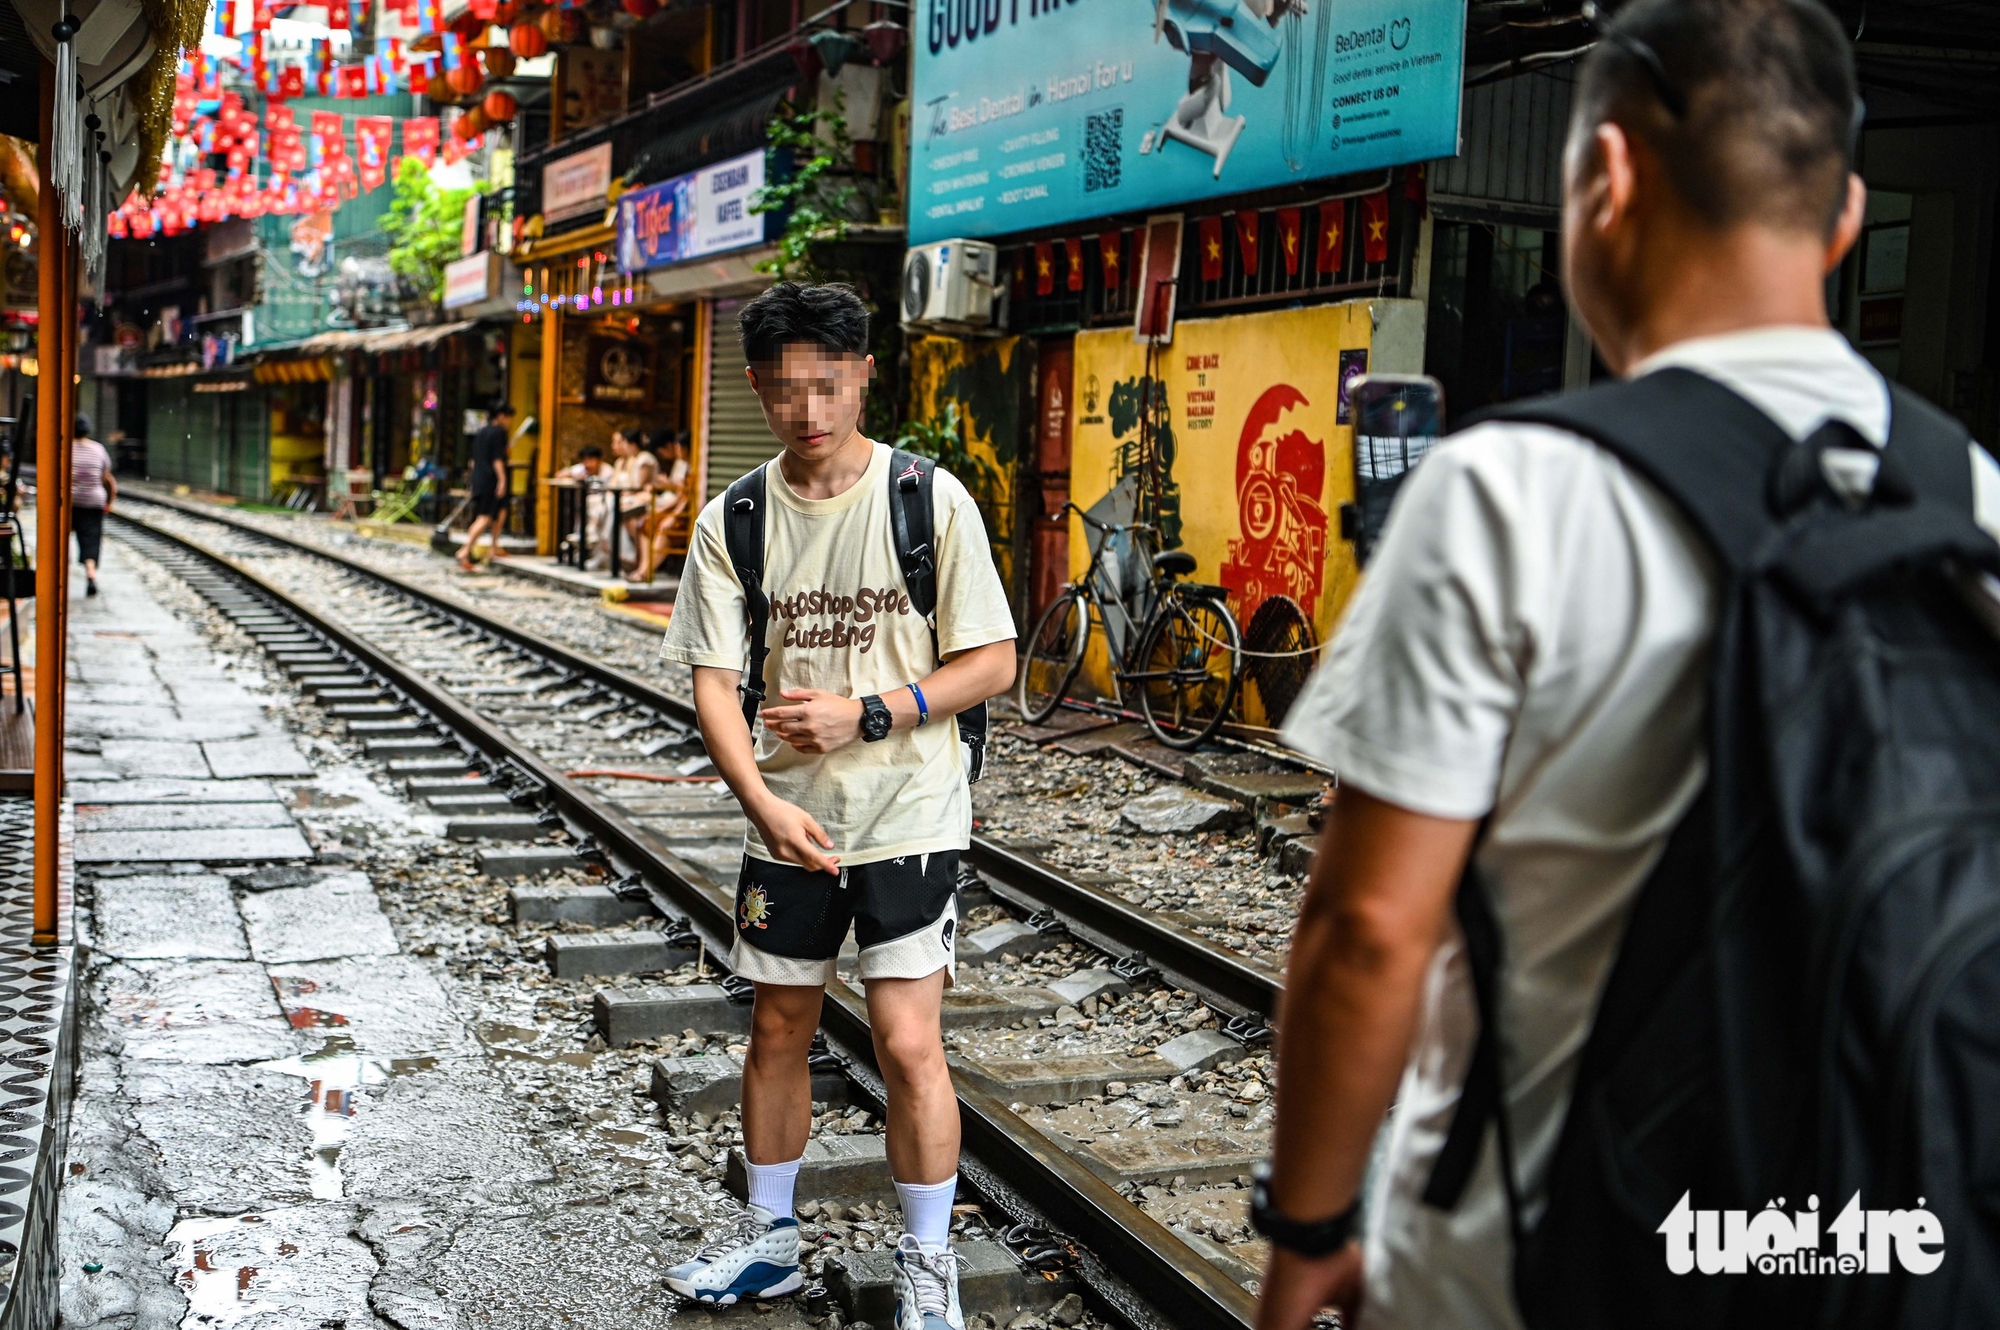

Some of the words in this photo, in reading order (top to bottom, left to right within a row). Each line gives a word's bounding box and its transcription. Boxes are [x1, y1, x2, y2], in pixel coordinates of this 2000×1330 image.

[1335, 23, 1386, 54] BeDental
[1333, 71, 1352, 86] Good
[1352, 65, 1374, 81] dental
[1374, 60, 1401, 76] service
[1402, 57, 1410, 71] in
[1411, 52, 1443, 68] Vietnam
[950, 105, 978, 132] Best
[980, 88, 1025, 124] Dental
[1029, 84, 1043, 108] in
[1046, 66, 1093, 105] Hanoi
[1094, 60, 1120, 89] for
[1120, 61, 1134, 83] u
[1332, 89, 1372, 109] CONNECT
[1373, 87, 1385, 101] US
[1386, 84, 1400, 98] ON
[1023, 184, 1050, 200] CANAL
[635, 190, 675, 256] Tiger
[1203, 353, 1219, 369] BACK
[1197, 373, 1206, 387] TO
[1187, 418, 1214, 430] HISTORY
